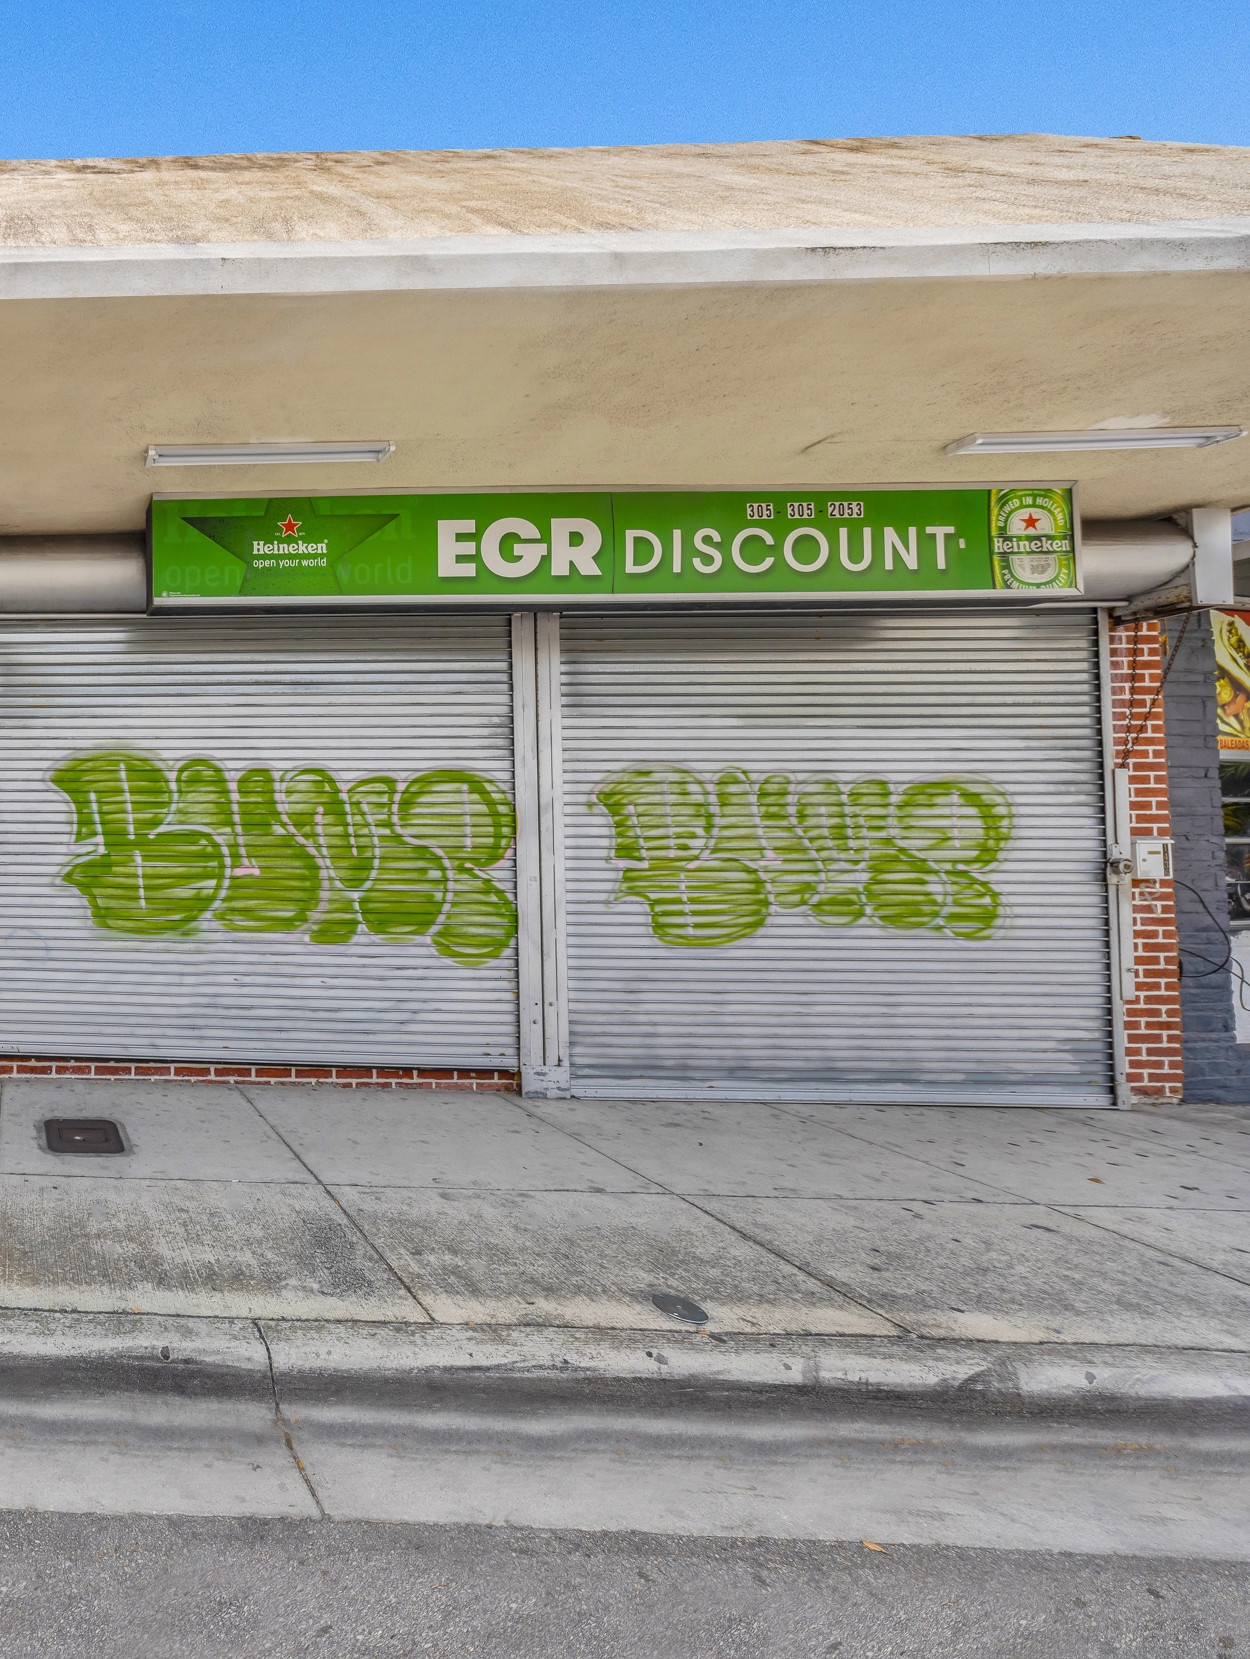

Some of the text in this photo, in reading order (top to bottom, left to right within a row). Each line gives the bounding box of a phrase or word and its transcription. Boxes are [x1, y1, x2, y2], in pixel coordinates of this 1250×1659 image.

[748, 503, 773, 518] 305
[788, 503, 813, 517] 305
[829, 502, 863, 517] 2053
[997, 496, 1065, 527] BREWED IN HOLLAND
[252, 540, 327, 555] Heineken
[438, 517, 602, 578] EGR
[625, 526, 955, 574] DISCOUNT
[994, 536, 1071, 552] Heineken
[253, 557, 327, 569] open your world
[1220, 738, 1250, 750] BALEADAS
